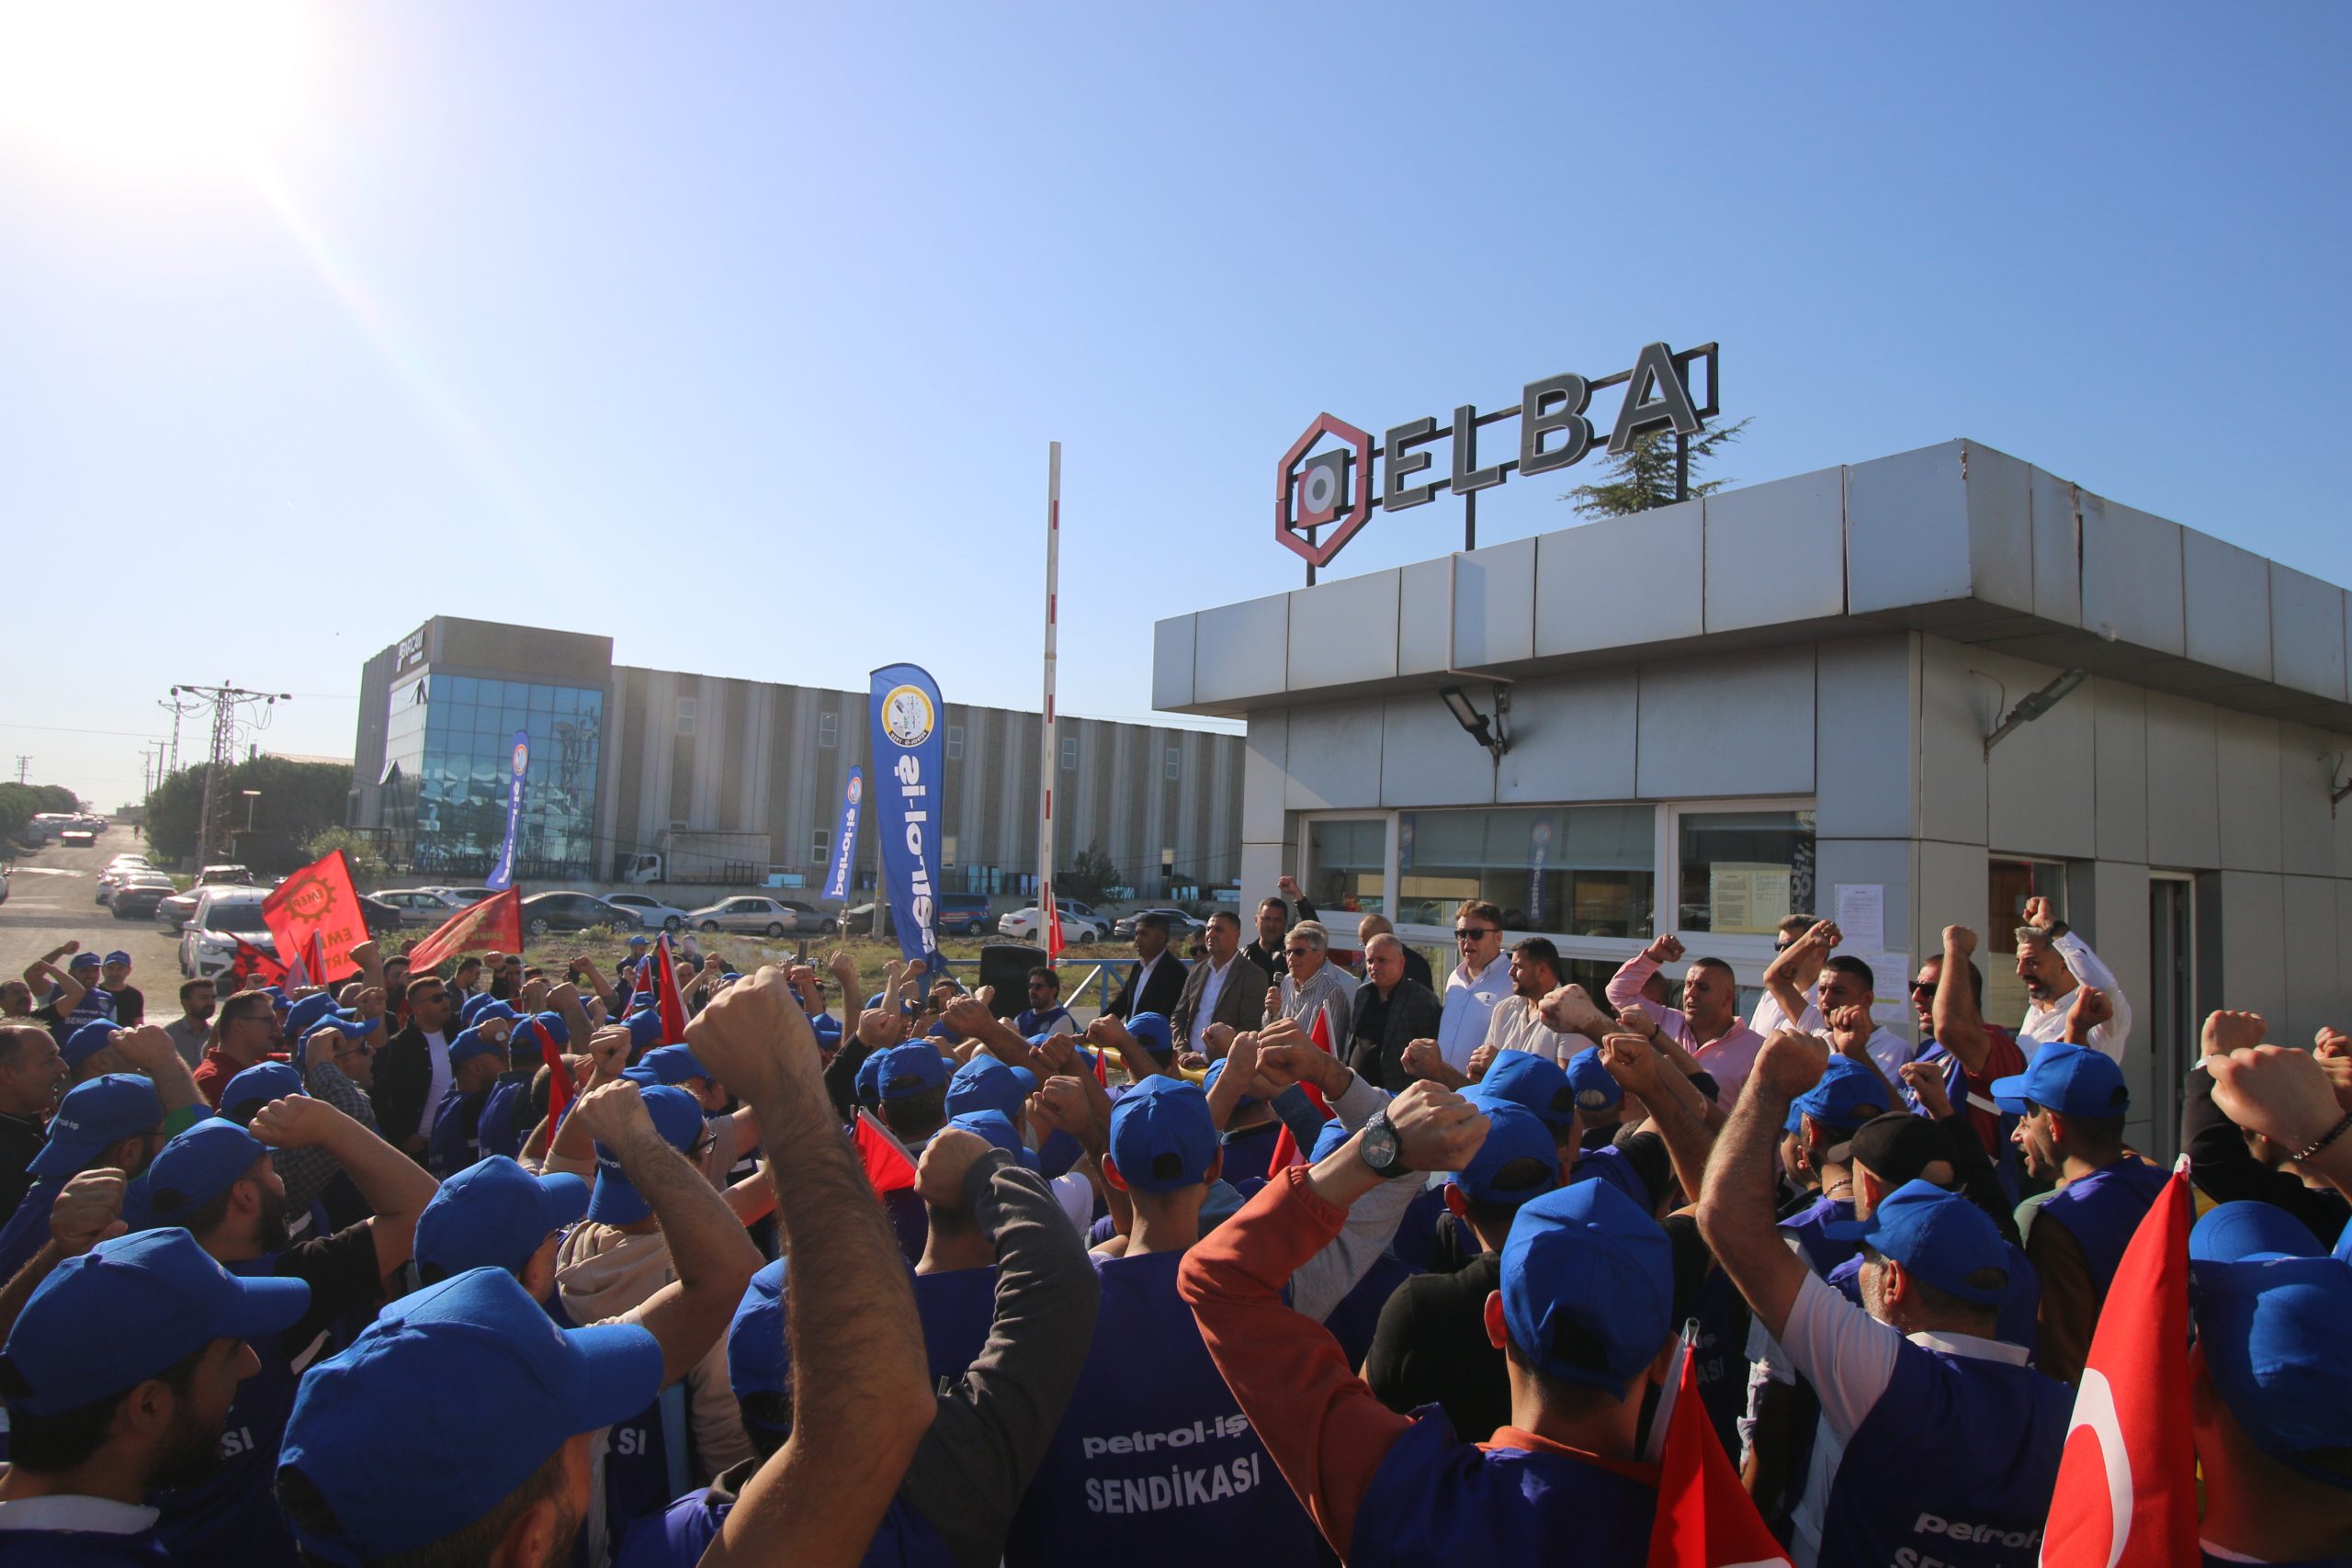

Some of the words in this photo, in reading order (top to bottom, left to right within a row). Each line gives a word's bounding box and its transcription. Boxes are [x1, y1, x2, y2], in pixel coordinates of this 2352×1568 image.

[1383, 341, 1704, 513] ELBA
[1082, 1414, 1249, 1459] petrol-iş
[1085, 1452, 1261, 1514] SENDİKASI
[1913, 1512, 2042, 1550] petrol-
